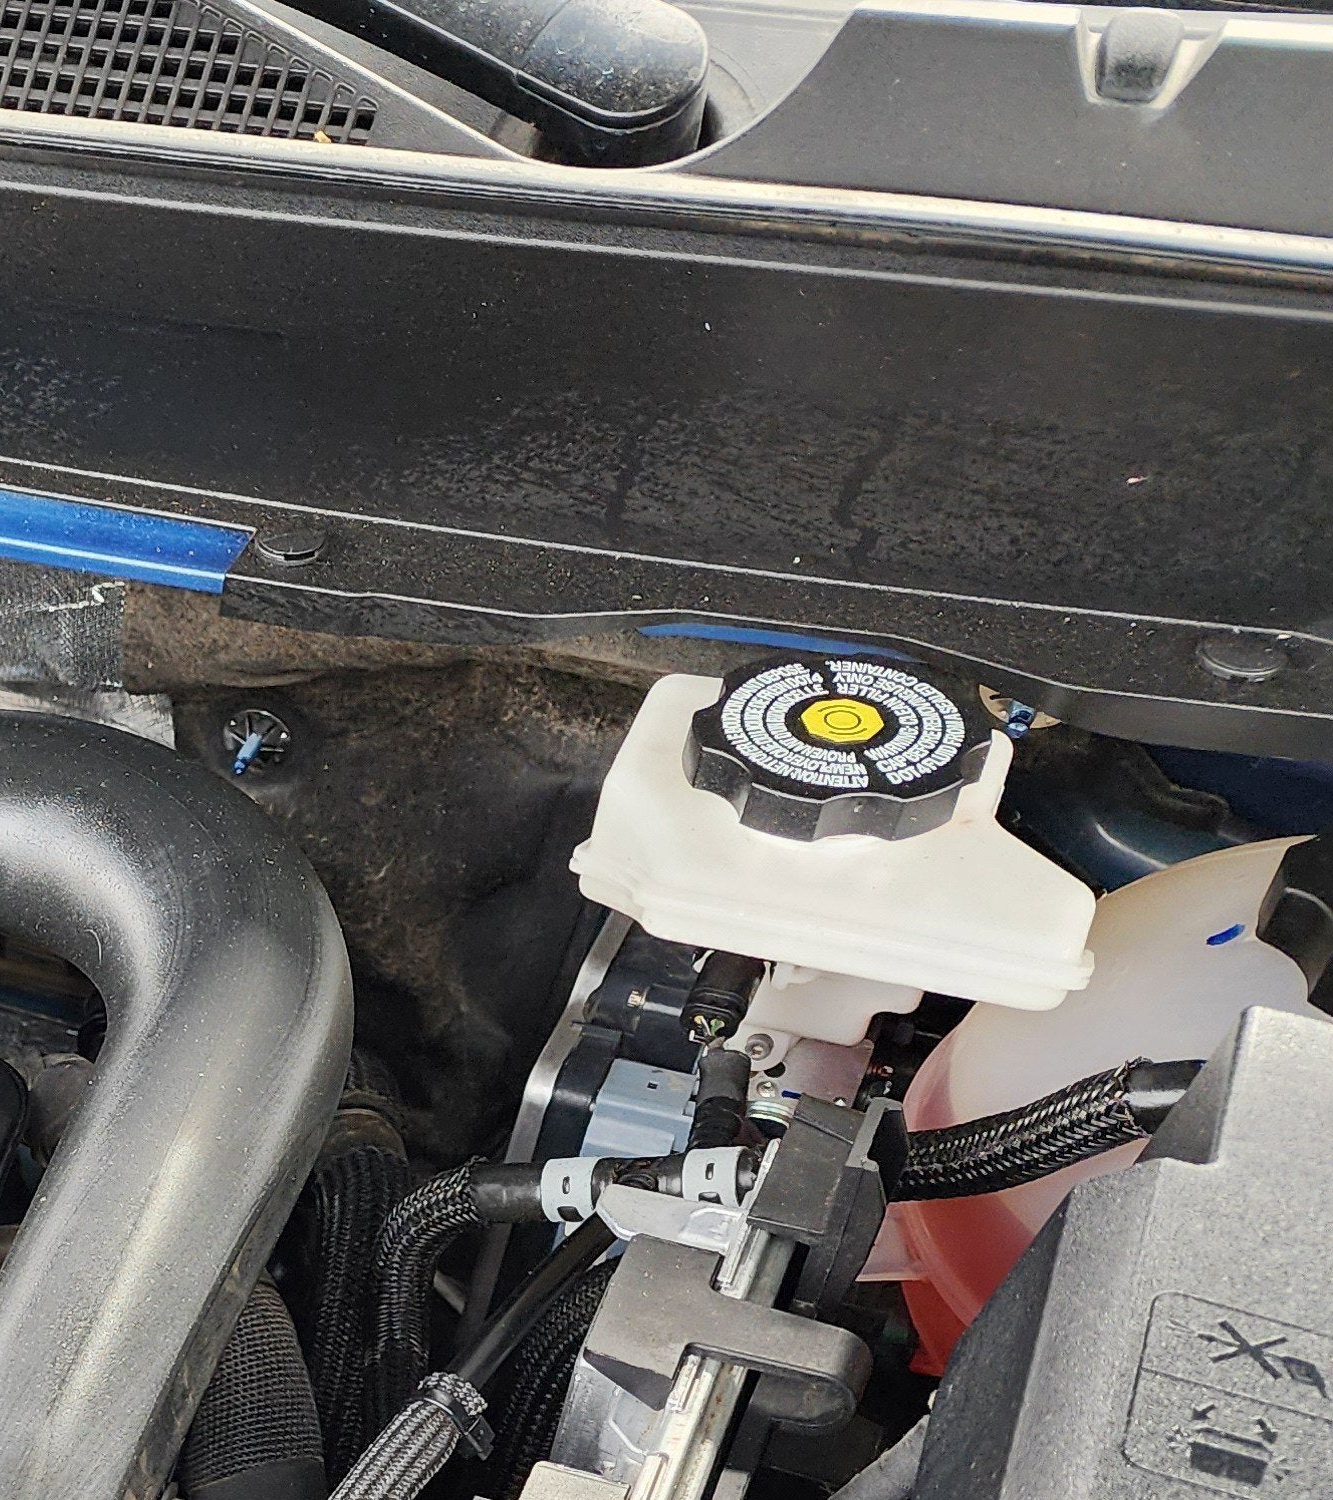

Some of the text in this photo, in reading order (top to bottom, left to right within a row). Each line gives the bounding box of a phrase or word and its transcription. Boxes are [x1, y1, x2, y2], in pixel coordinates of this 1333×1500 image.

[785, 672, 813, 688] DOT
[833, 672, 876, 685] ONLY
[873, 678, 906, 695] USE
[837, 683, 894, 702] FILLER
[914, 683, 957, 714] SEALED
[883, 696, 918, 725] CLEAN
[943, 720, 964, 747] FROM
[902, 730, 941, 762] BEFORE
[876, 755, 906, 772] CAP
[921, 744, 957, 770] FLUID
[886, 766, 923, 784] DOT
